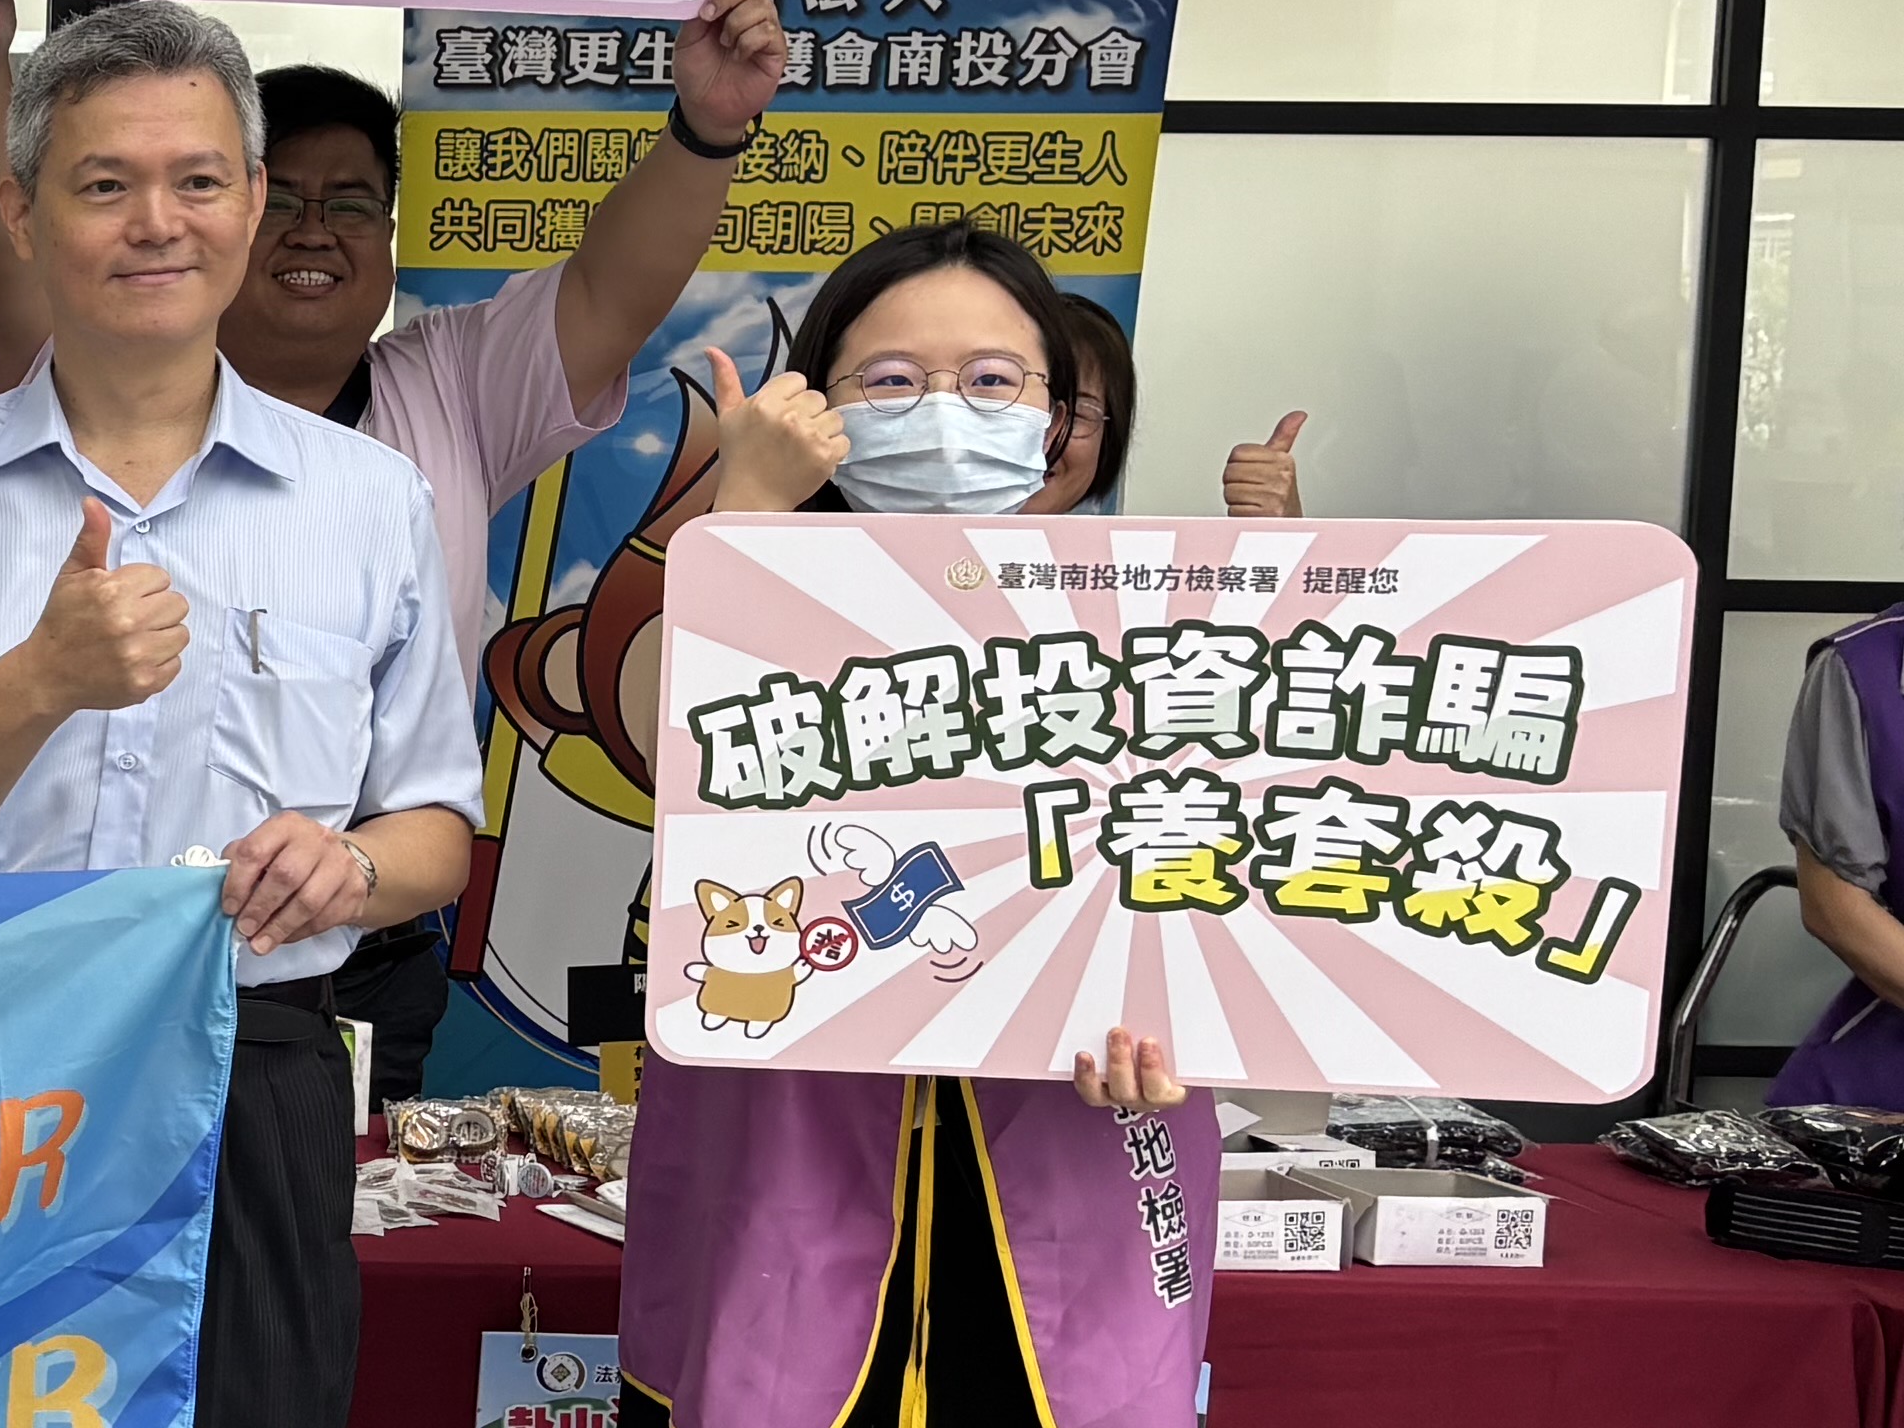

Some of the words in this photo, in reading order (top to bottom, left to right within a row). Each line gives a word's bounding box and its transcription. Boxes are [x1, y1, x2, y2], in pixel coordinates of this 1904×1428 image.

[436, 28, 1142, 89] 臺灣更生會南投分會
[997, 561, 1279, 596] 臺灣南投地方檢察署
[1302, 565, 1399, 597] 提醒您
[700, 630, 1575, 804] 破解投資詐騙
[1030, 775, 1641, 982] 「養套殺」
[1114, 1104, 1193, 1304] 地檢署
